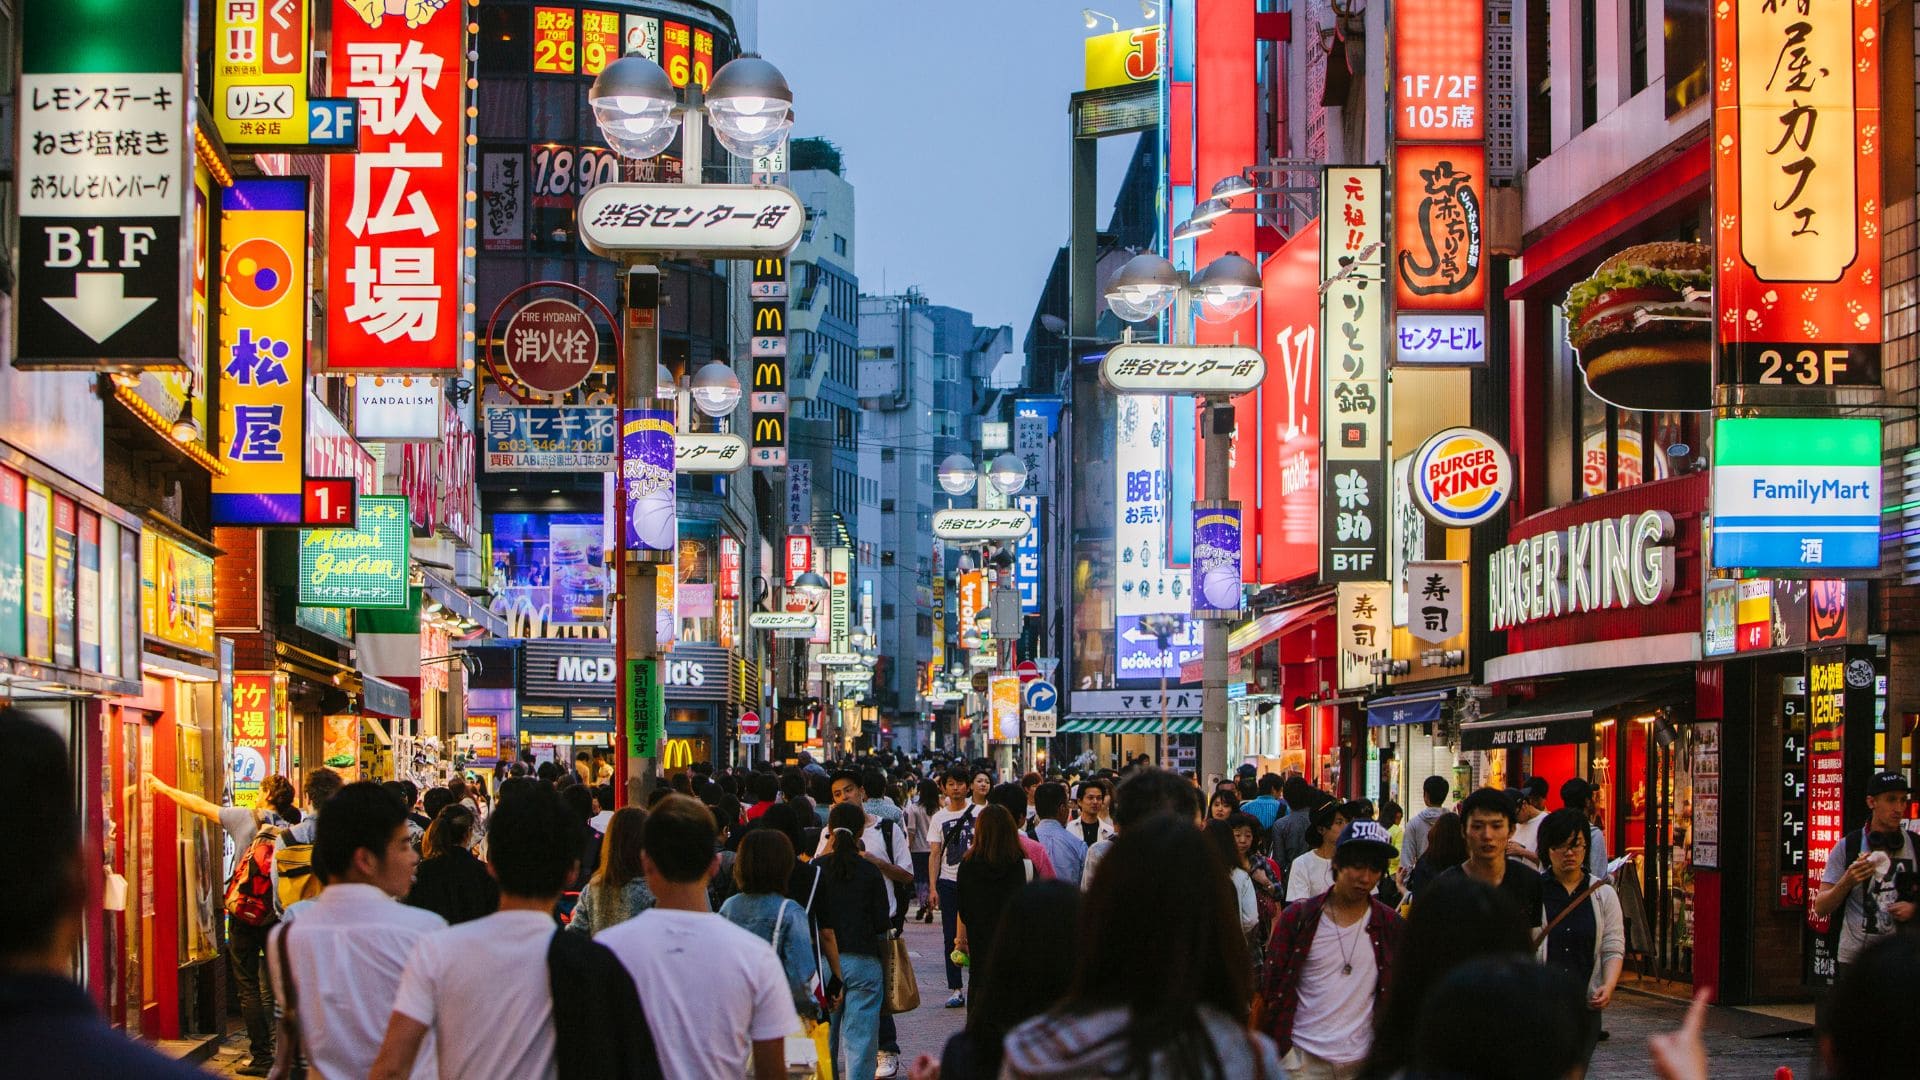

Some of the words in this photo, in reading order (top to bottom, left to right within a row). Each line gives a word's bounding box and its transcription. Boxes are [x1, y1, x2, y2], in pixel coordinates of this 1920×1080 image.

[32, 87, 172, 111] レモンステーキ
[235, 91, 286, 116] りらく
[240, 122, 281, 135] 渋谷店
[311, 106, 353, 139] 2F
[1405, 105, 1474, 128] 105席
[1762, 0, 1829, 237] 屋カフェ
[33, 131, 169, 156] ねぎ塩焼き
[30, 175, 171, 200] おろししそハンバーグ
[345, 40, 444, 344] 歌広場
[592, 204, 791, 229] 渋谷センター街
[44, 226, 157, 268] B1F
[521, 312, 540, 323] FIRE
[542, 312, 582, 323] HYDRANT
[514, 329, 590, 364] 消火栓
[1399, 327, 1482, 351] センタービル
[1115, 358, 1259, 378] 渋谷センター街
[226, 328, 290, 461] 松屋
[363, 397, 433, 405] VANDALISM
[520, 409, 614, 438] セキネ
[509, 439, 602, 452] 03-3464-2061
[490, 454, 514, 466] 買取
[1282, 449, 1310, 496] mobile
[1429, 449, 1495, 478] BURGER
[1432, 466, 1498, 503] KING
[1753, 480, 1870, 503] FamilyMart
[315, 487, 348, 520] 1F
[1335, 469, 1372, 542] 米助
[938, 518, 1026, 530] 渋谷センター街
[304, 527, 382, 550] Miami
[1800, 538, 1823, 563] 酒
[1333, 554, 1373, 571] B1F
[1568, 510, 1675, 612] KING
[313, 588, 389, 597] マイアミガーデン
[1489, 530, 1561, 631] BURGER
[1421, 573, 1449, 632] 寿司
[1352, 593, 1377, 647] 寿司
[1750, 626, 1761, 646] 4F
[558, 656, 705, 686] McDld's
[1811, 663, 1843, 691] 飲み放題
[634, 664, 648, 753] 客引きは犯罪です
[238, 739, 267, 747] ROOM
